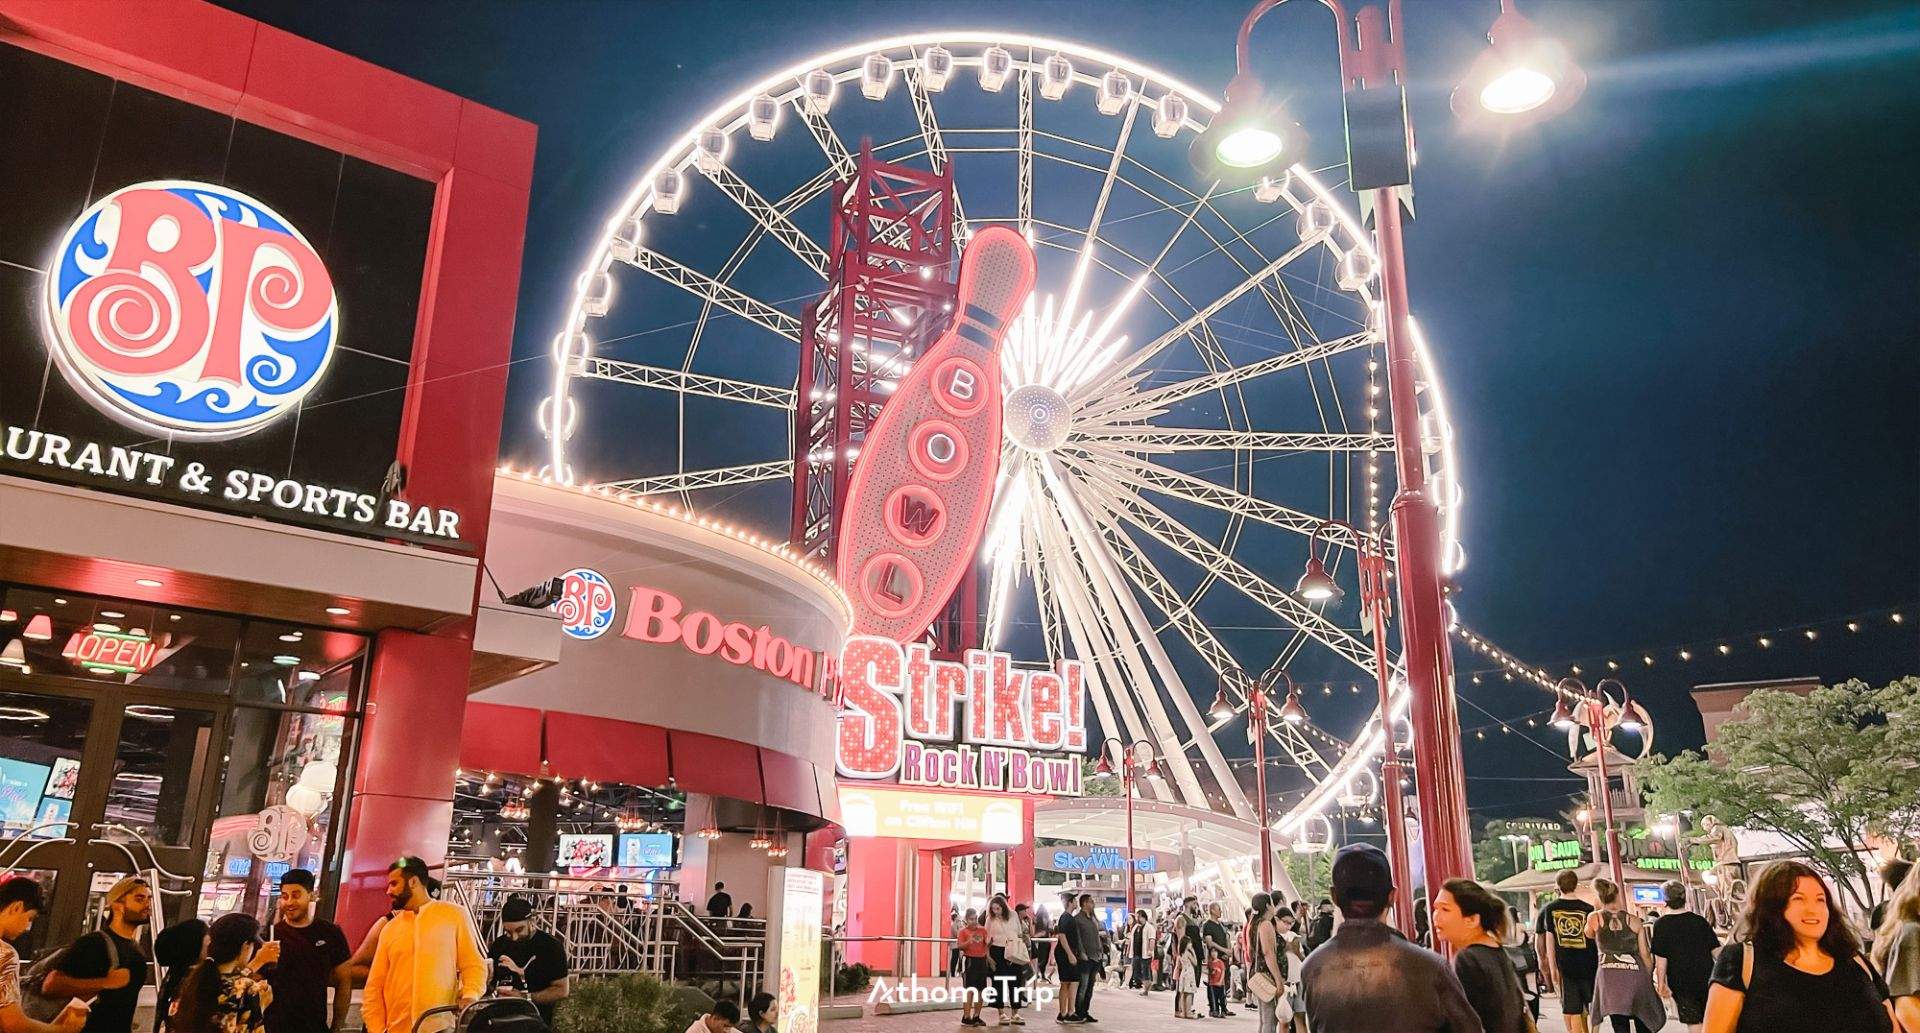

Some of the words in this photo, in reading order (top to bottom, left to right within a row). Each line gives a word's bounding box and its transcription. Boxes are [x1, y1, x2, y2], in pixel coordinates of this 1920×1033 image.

[0, 426, 174, 486] URANT
[179, 462, 213, 494] &
[223, 469, 377, 523] SPORTS
[385, 500, 460, 539] BAR
[77, 634, 156, 668] OPEN
[621, 584, 813, 690] Boston
[836, 635, 1088, 779] Strike!
